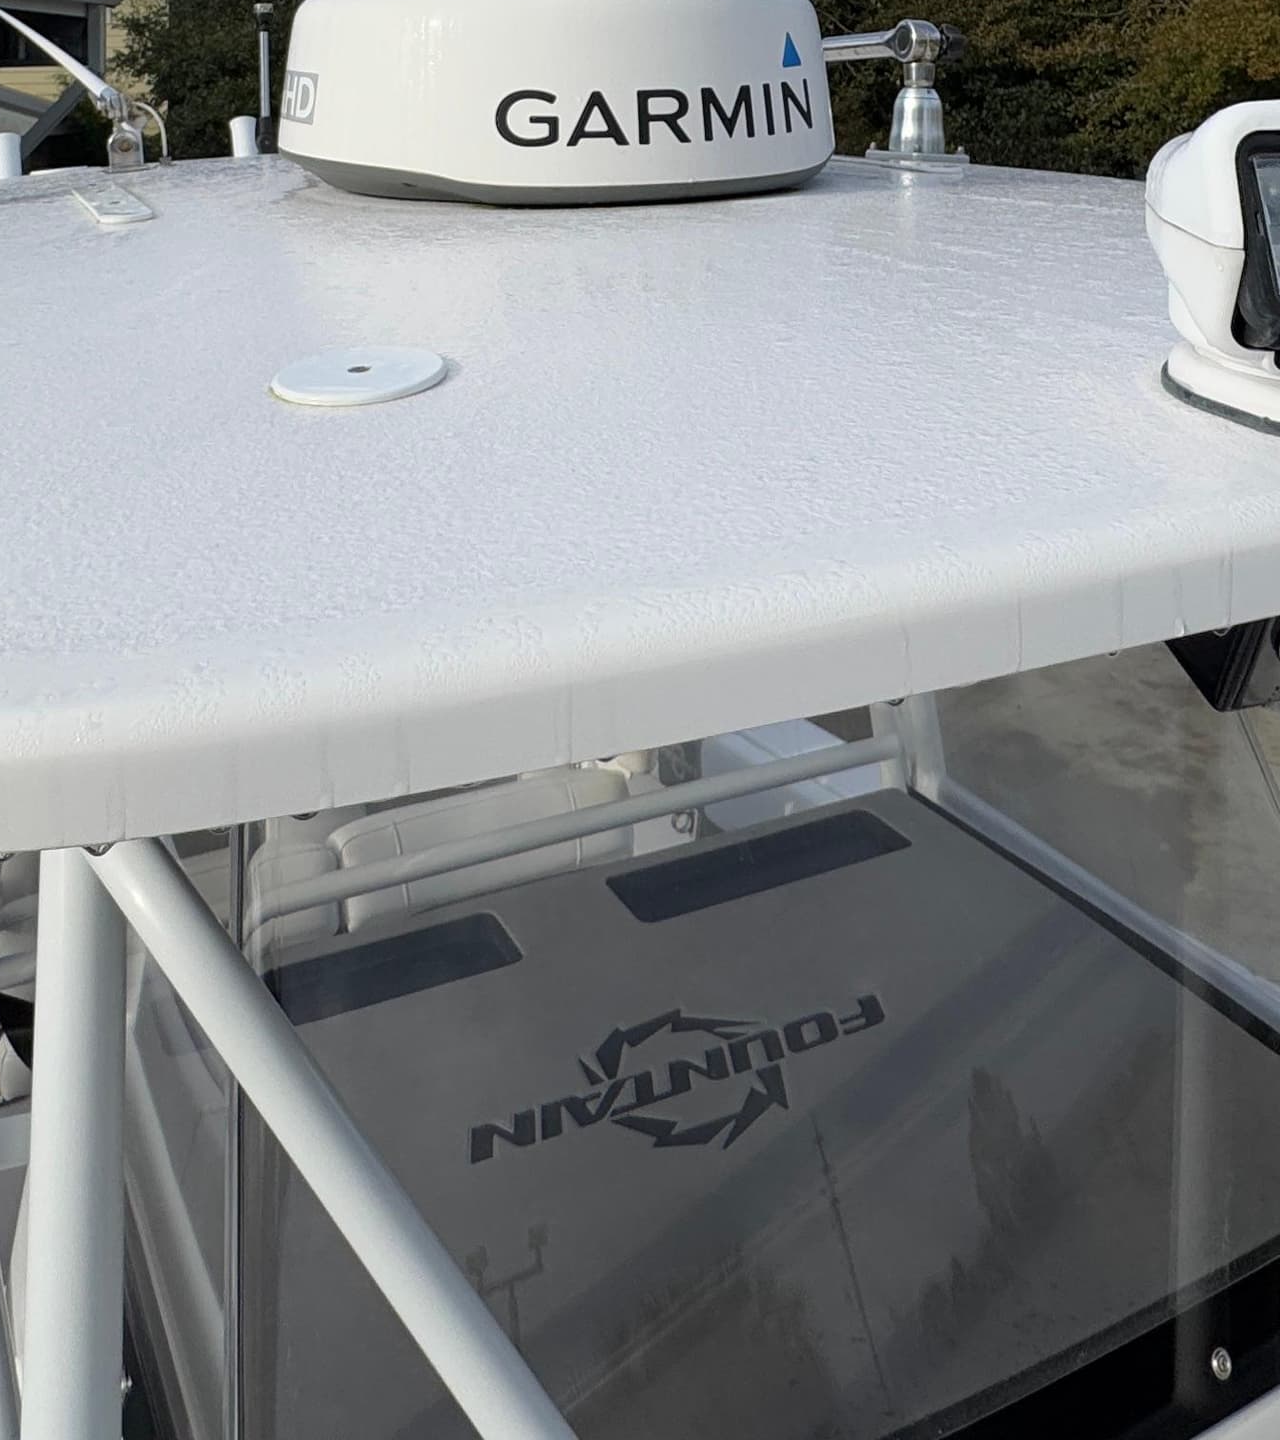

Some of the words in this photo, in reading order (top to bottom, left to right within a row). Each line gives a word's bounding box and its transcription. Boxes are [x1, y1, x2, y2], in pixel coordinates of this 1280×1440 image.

[282, 73, 315, 119] HD
[495, 78, 813, 147] GARMIN
[470, 993, 886, 1164] FOUNTAIN
